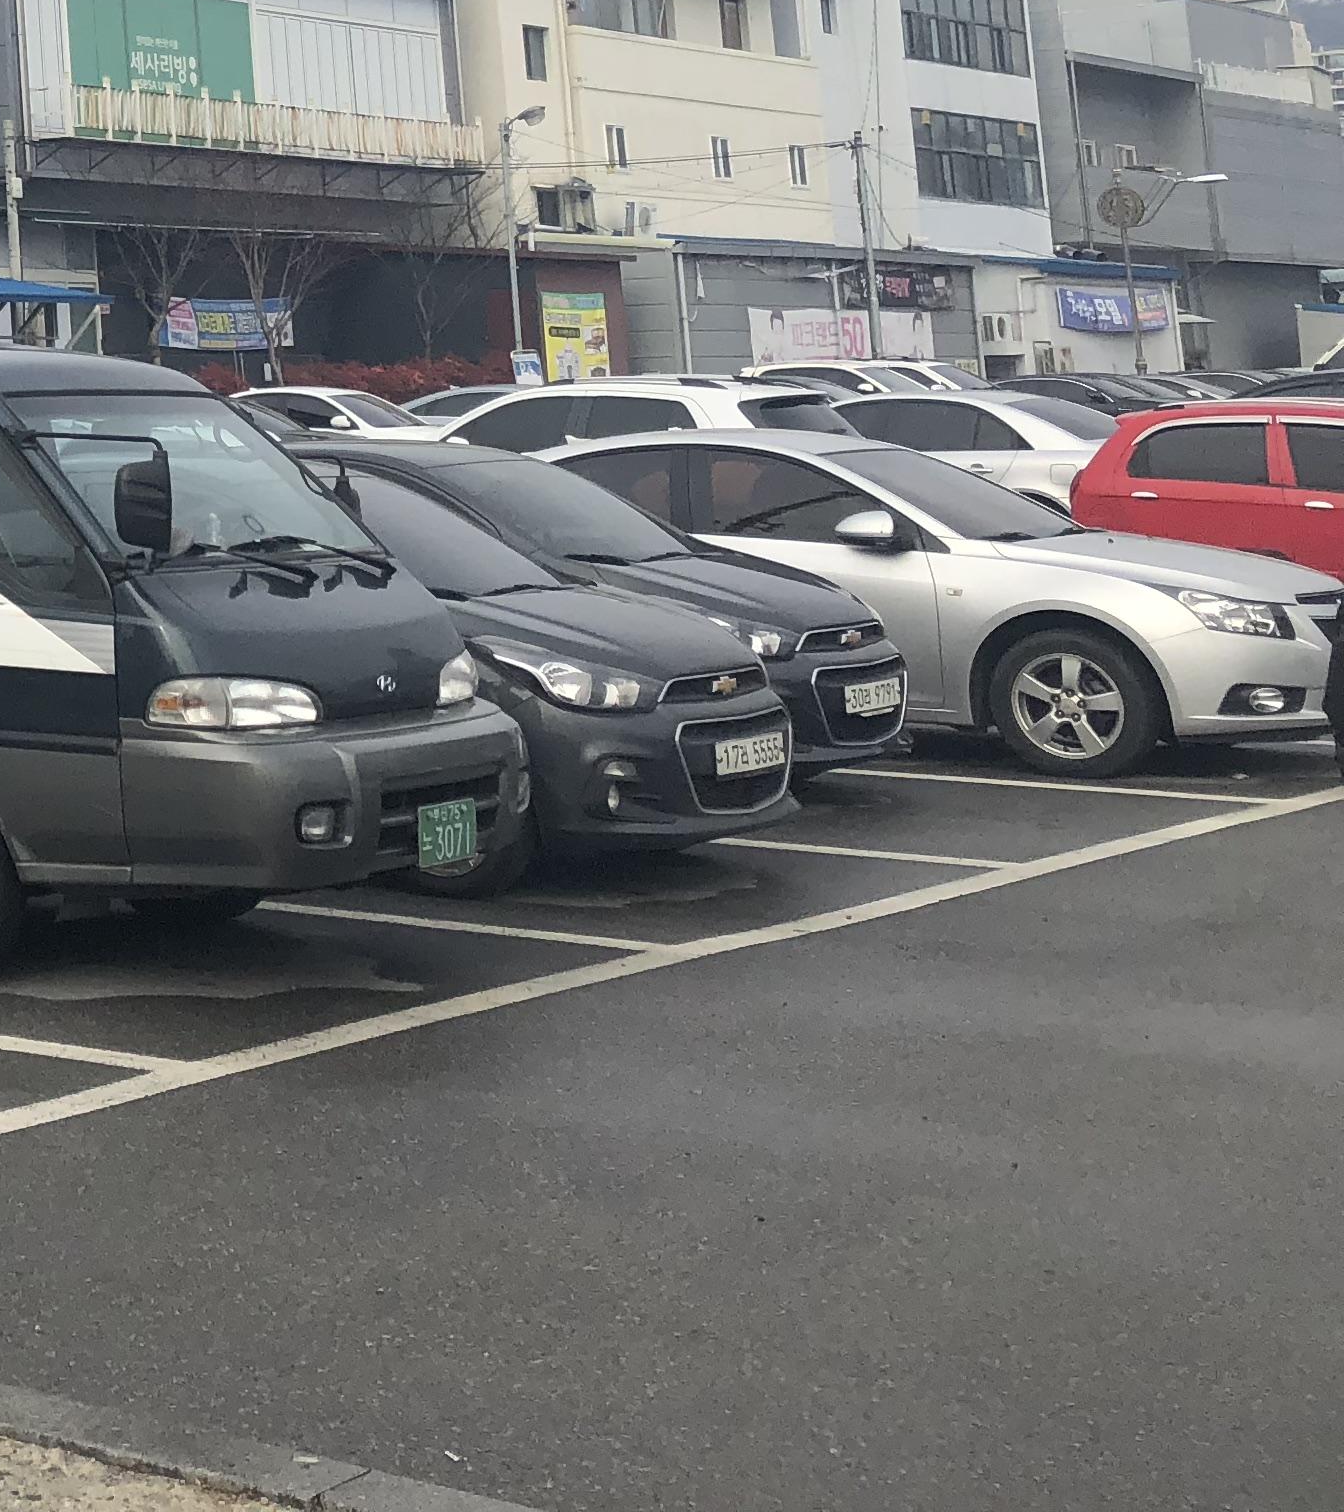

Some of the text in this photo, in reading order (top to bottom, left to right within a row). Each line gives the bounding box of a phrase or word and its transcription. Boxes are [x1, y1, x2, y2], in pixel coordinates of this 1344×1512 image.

[130, 51, 187, 85] 세사리빙
[840, 316, 866, 358] 50
[752, 737, 781, 765] 5555
[435, 822, 470, 861] 3071
